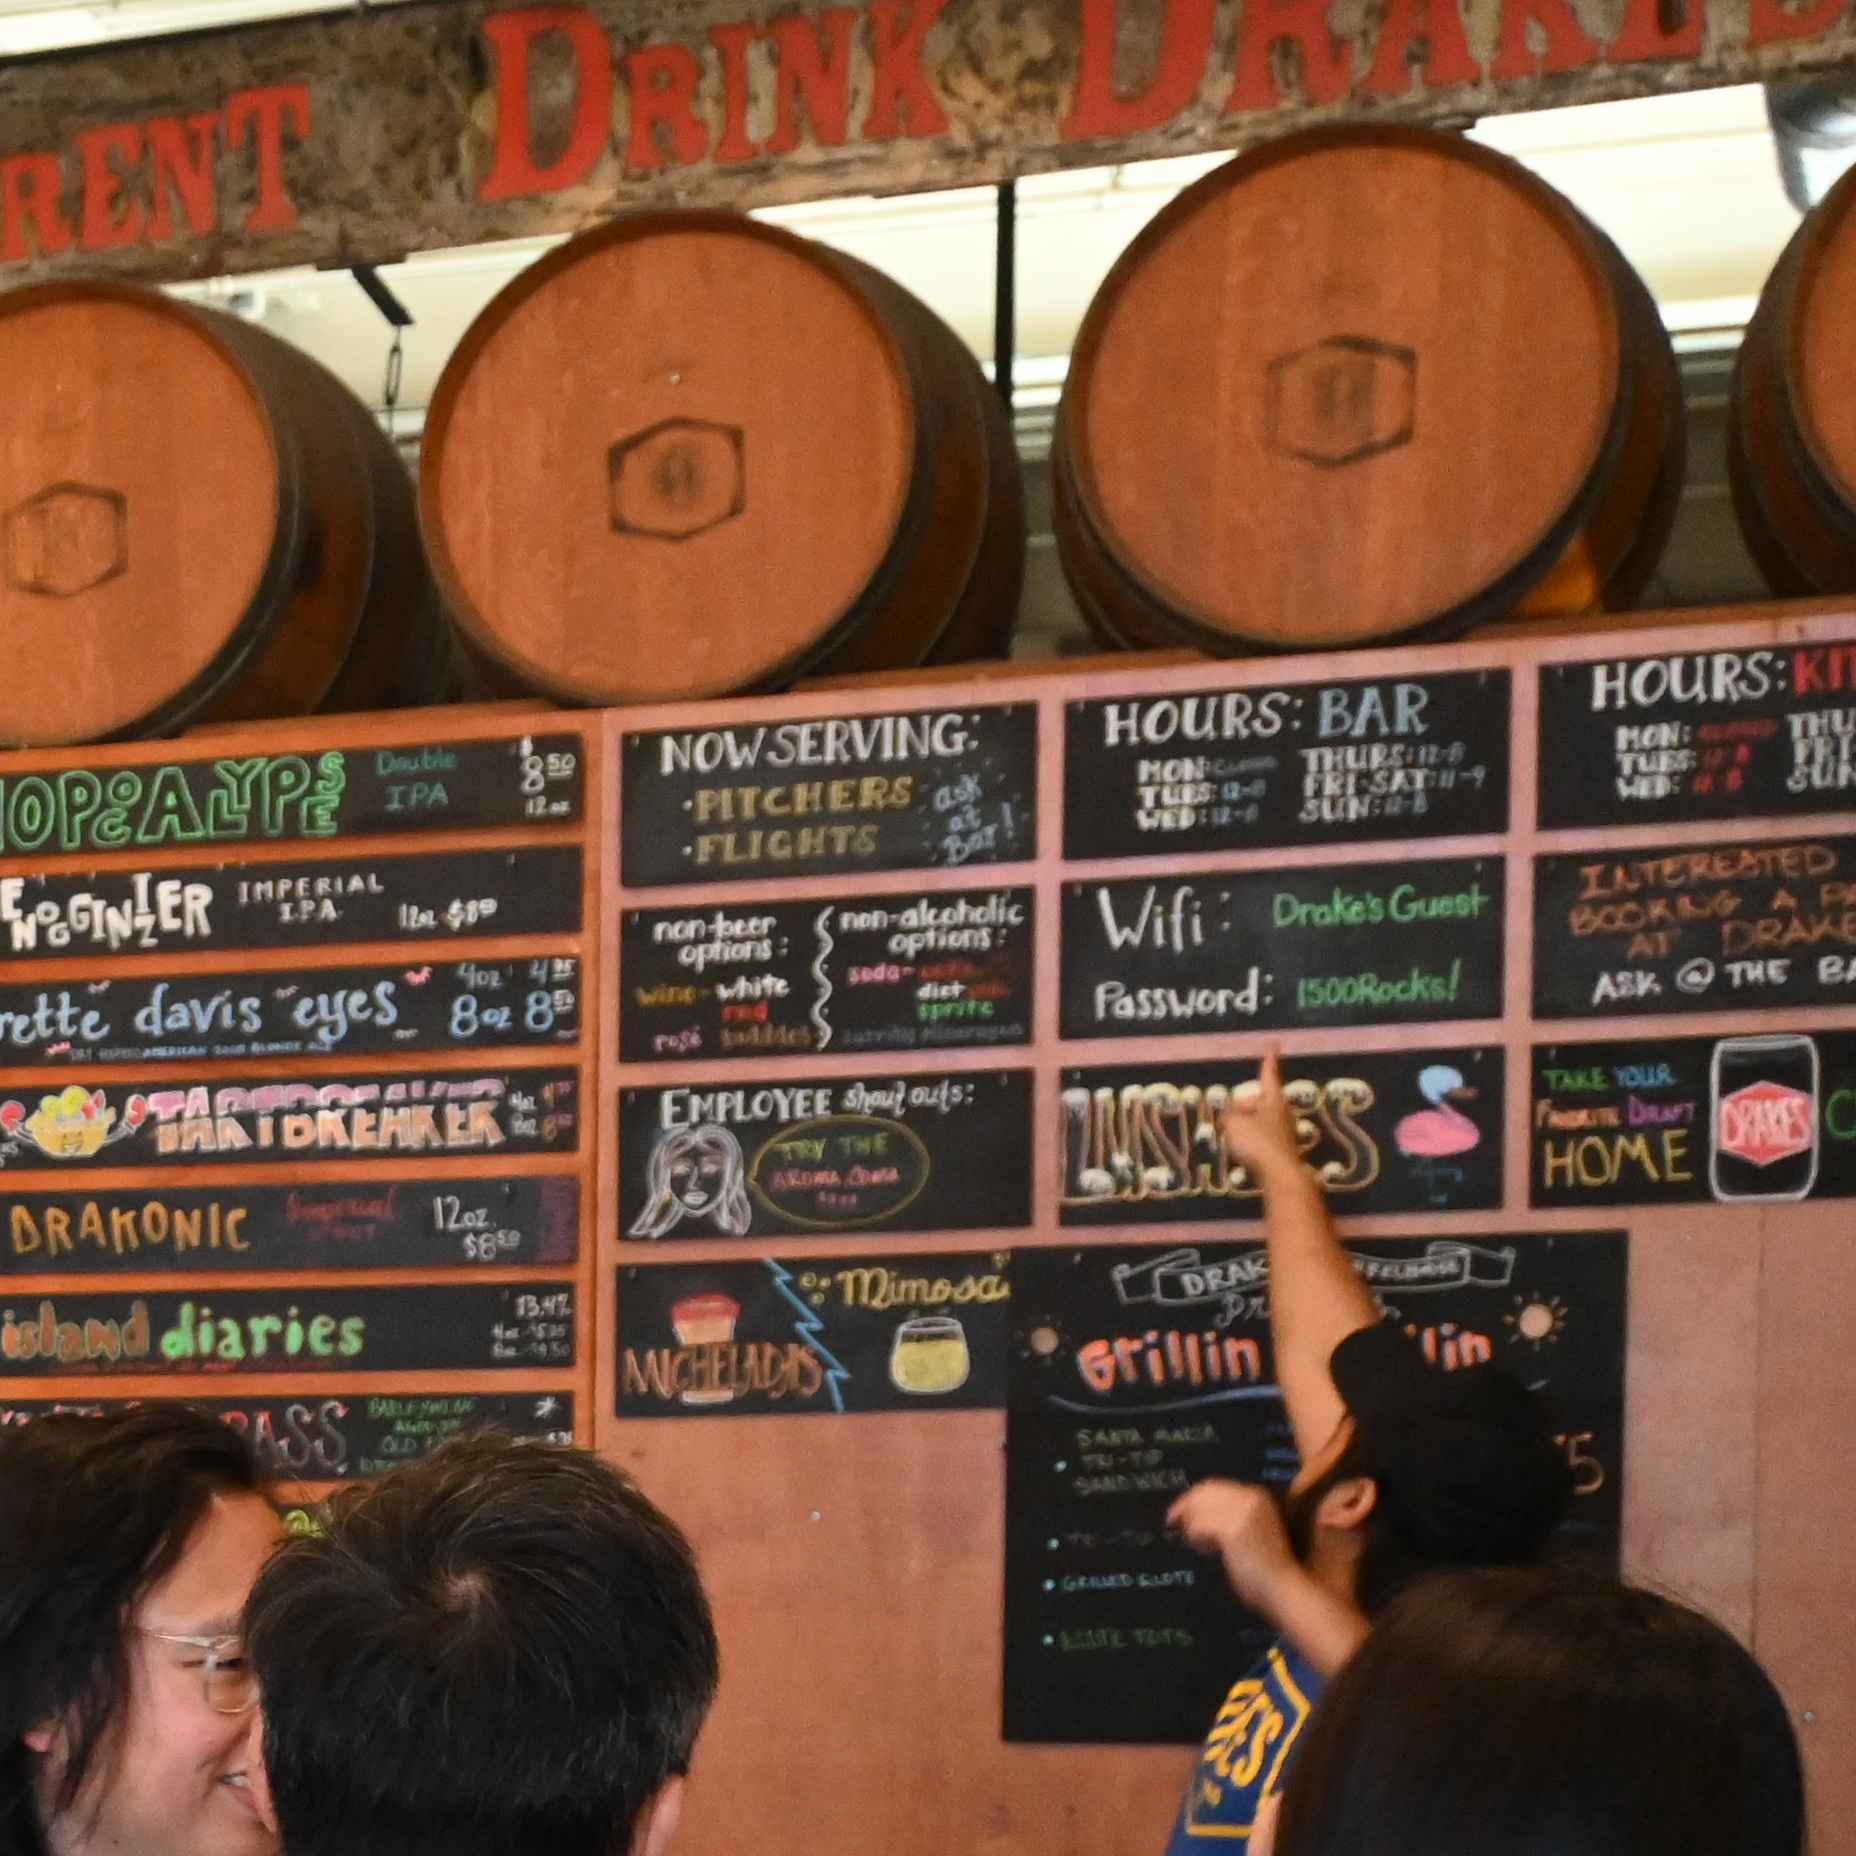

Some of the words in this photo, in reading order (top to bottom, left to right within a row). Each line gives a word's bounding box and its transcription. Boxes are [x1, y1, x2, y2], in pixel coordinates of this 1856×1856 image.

[1591, 651, 1786, 711] HOURS:
[1103, 692, 1304, 747] HOURS:
[1318, 684, 1430, 739] BAR
[659, 730, 763, 776] NOW
[767, 714, 982, 768] SERVING:
[694, 775, 914, 823] PITCHERS
[694, 824, 881, 865] FLIGHTS
[238, 873, 385, 904] IMPERIAL
[1390, 883, 1491, 923] Guest
[839, 897, 1025, 934] non-alcoholic
[715, 974, 791, 1001] white
[1675, 958, 1716, 993] @
[1723, 958, 1792, 989] THE
[134, 981, 263, 1040] davis
[292, 981, 398, 1049] eyes
[1543, 1068, 1609, 1090] TAKE
[1612, 1062, 1680, 1089] YOUR
[660, 1086, 833, 1131] EMPLOYEE
[1543, 1128, 1696, 1188] HOME
[9, 1200, 253, 1256] DRAKONIC
[0, 1300, 151, 1363] island
[159, 1303, 369, 1362] diaries
